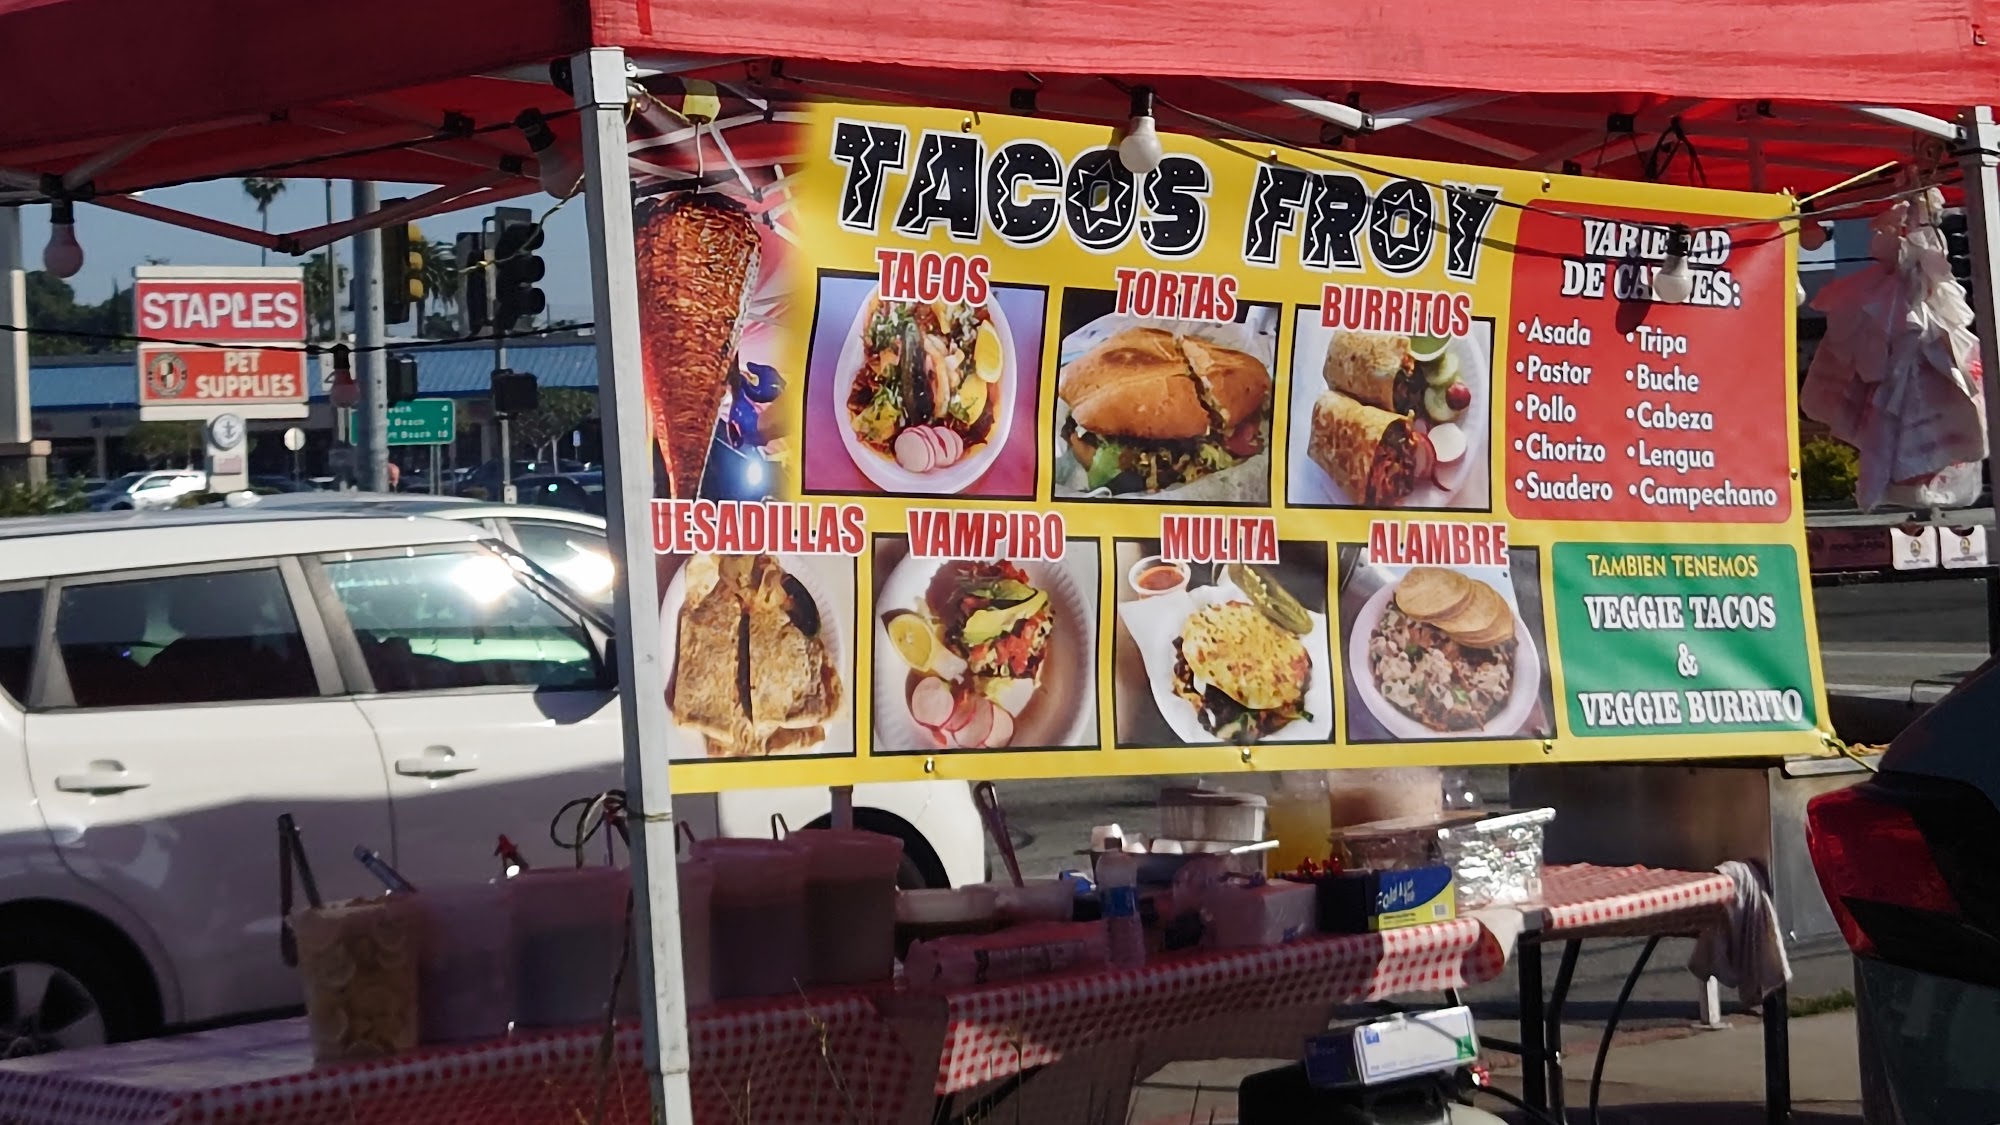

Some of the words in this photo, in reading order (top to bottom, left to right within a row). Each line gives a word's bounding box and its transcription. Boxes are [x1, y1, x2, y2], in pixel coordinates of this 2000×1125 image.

[833, 118, 1213, 256] TACOS
[1243, 163, 1500, 281] FROY
[1584, 220, 1731, 265] VARIEAD
[876, 249, 991, 307] TACOS
[1562, 260, 1606, 297] DE
[1614, 264, 1740, 307] CAES:
[143, 292, 299, 330] STAPLES
[1115, 269, 1238, 323] TORTAS
[1321, 285, 1471, 337] BURRITOS
[1527, 316, 1591, 346] Asada
[1636, 326, 1687, 358] Tripa
[224, 352, 262, 374] PET
[1527, 356, 1592, 385] Pastor
[1637, 364, 1699, 392] Buche
[196, 374, 296, 398] SUPPLIES
[1526, 394, 1577, 423] Pollo
[1637, 402, 1713, 430] Cabeza
[1526, 433, 1606, 462] Chorizo
[1639, 440, 1714, 474] Lengua
[1526, 472, 1613, 501] Suadero
[1640, 478, 1777, 511] Campechano
[651, 500, 866, 556] UESADILLAS
[907, 509, 1066, 561] VAMPIRO
[1162, 514, 1279, 564] MULITA
[1369, 521, 1509, 566] ALAMBRE
[1587, 555, 1667, 577] TAMBIEN
[1671, 555, 1759, 578] TENEMOS
[1584, 595, 1684, 629] VEGGIE
[1688, 595, 1777, 629] TACOS
[1677, 643, 1698, 677] &
[1578, 690, 1682, 726] VEGGIE
[1685, 689, 1803, 722] BURRITO
